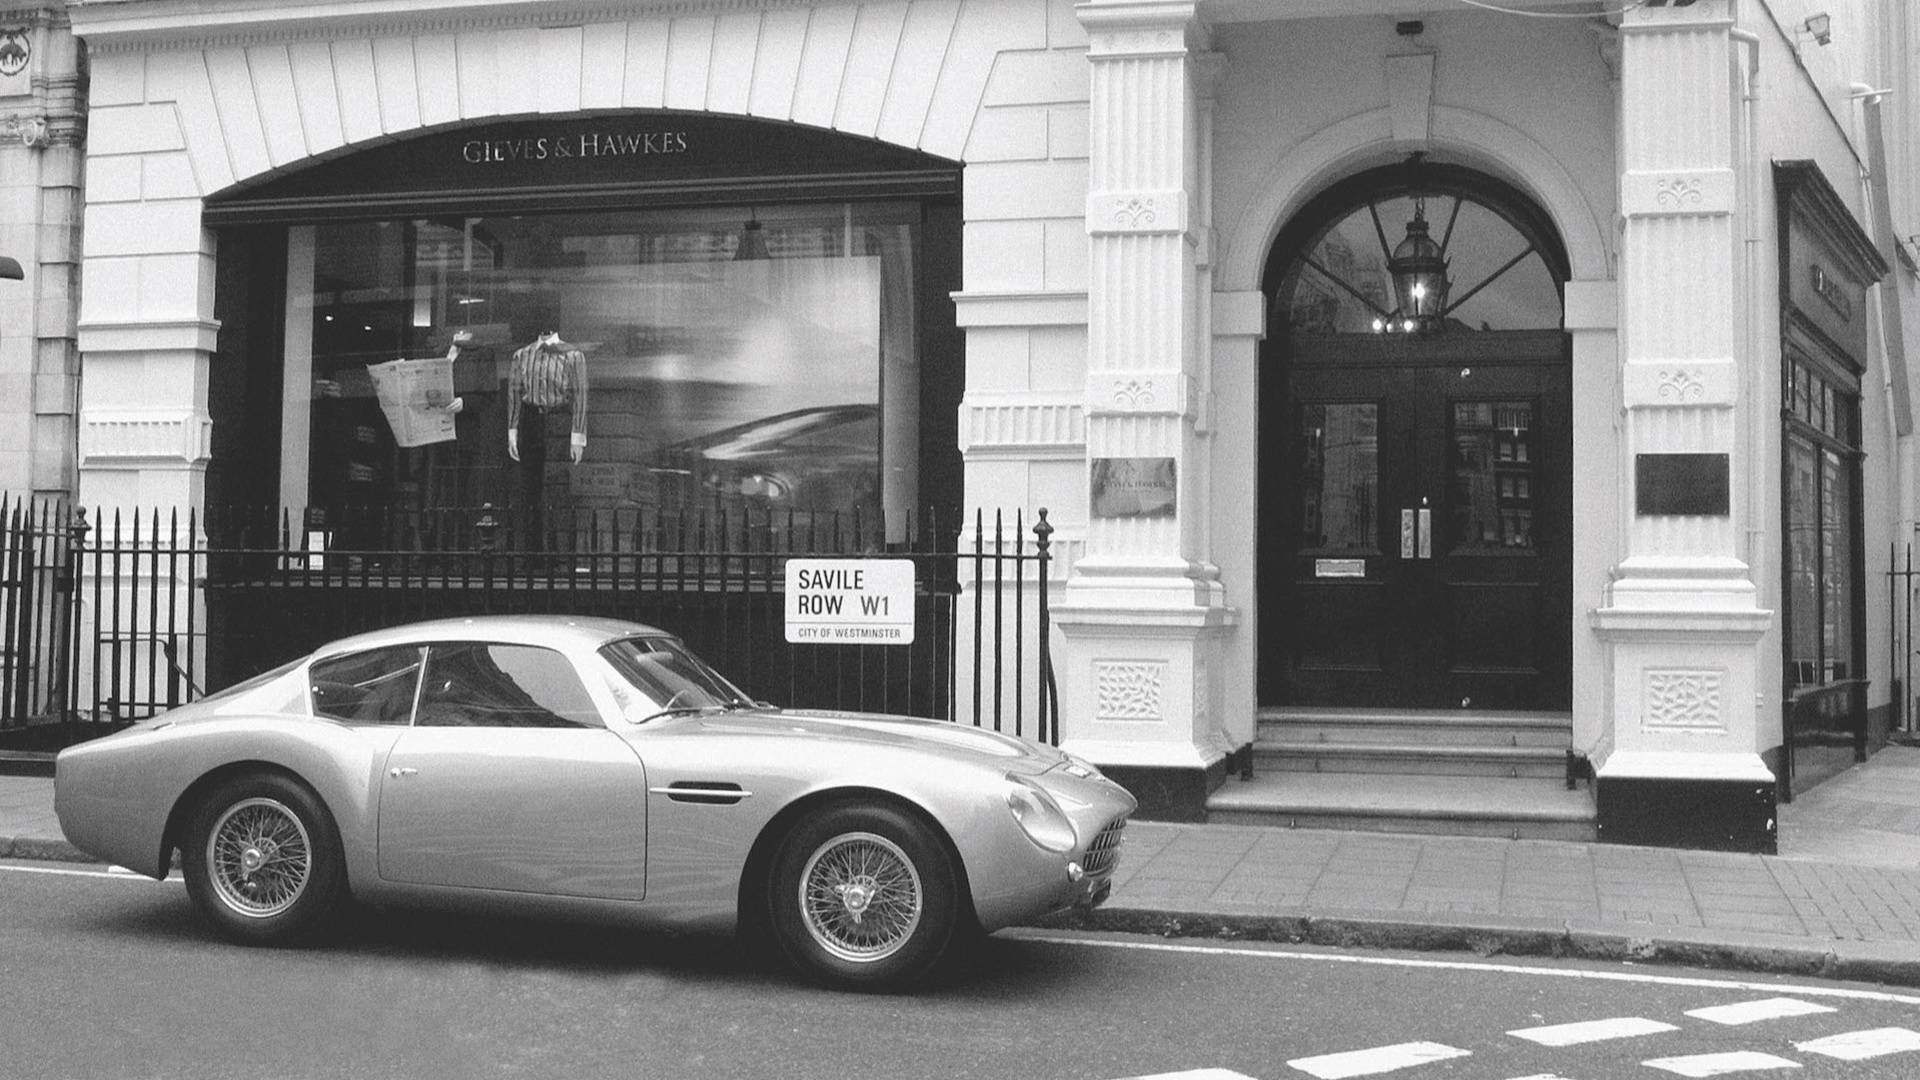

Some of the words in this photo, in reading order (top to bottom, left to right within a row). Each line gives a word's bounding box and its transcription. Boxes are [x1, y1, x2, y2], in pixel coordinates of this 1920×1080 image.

[554, 136, 574, 158] &
[579, 132, 688, 158] HAWKES
[798, 569, 864, 590] SAVILE
[798, 594, 843, 615] ROW
[860, 596, 889, 616] W1
[798, 628, 819, 638] CITY
[820, 628, 831, 638] OF
[835, 628, 901, 638] WESTMINSTER
